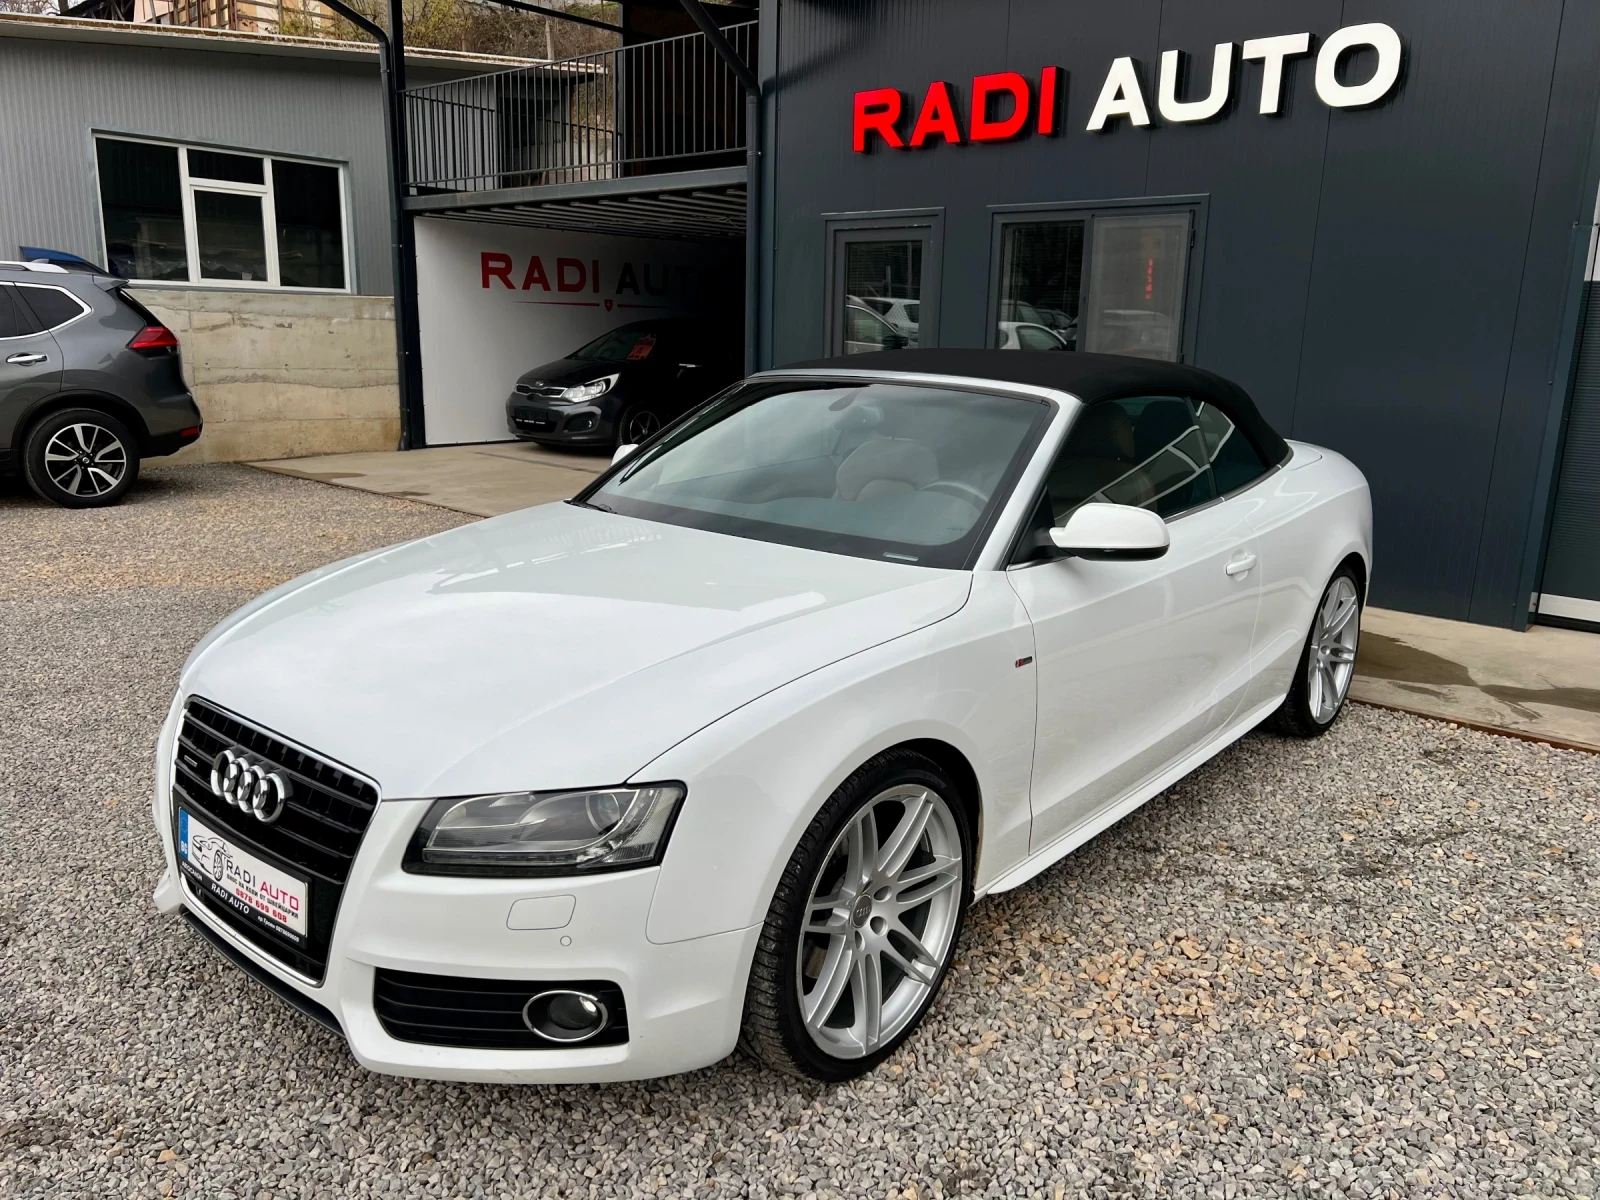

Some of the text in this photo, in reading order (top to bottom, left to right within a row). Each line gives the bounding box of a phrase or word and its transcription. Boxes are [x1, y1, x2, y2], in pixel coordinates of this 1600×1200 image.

[852, 22, 1404, 152] RADI AUTO
[481, 252, 600, 293] RADI
[211, 882, 250, 914] RADI AUTO
[226, 859, 299, 911] RADI AUTO
[235, 888, 253, 904] 0878
